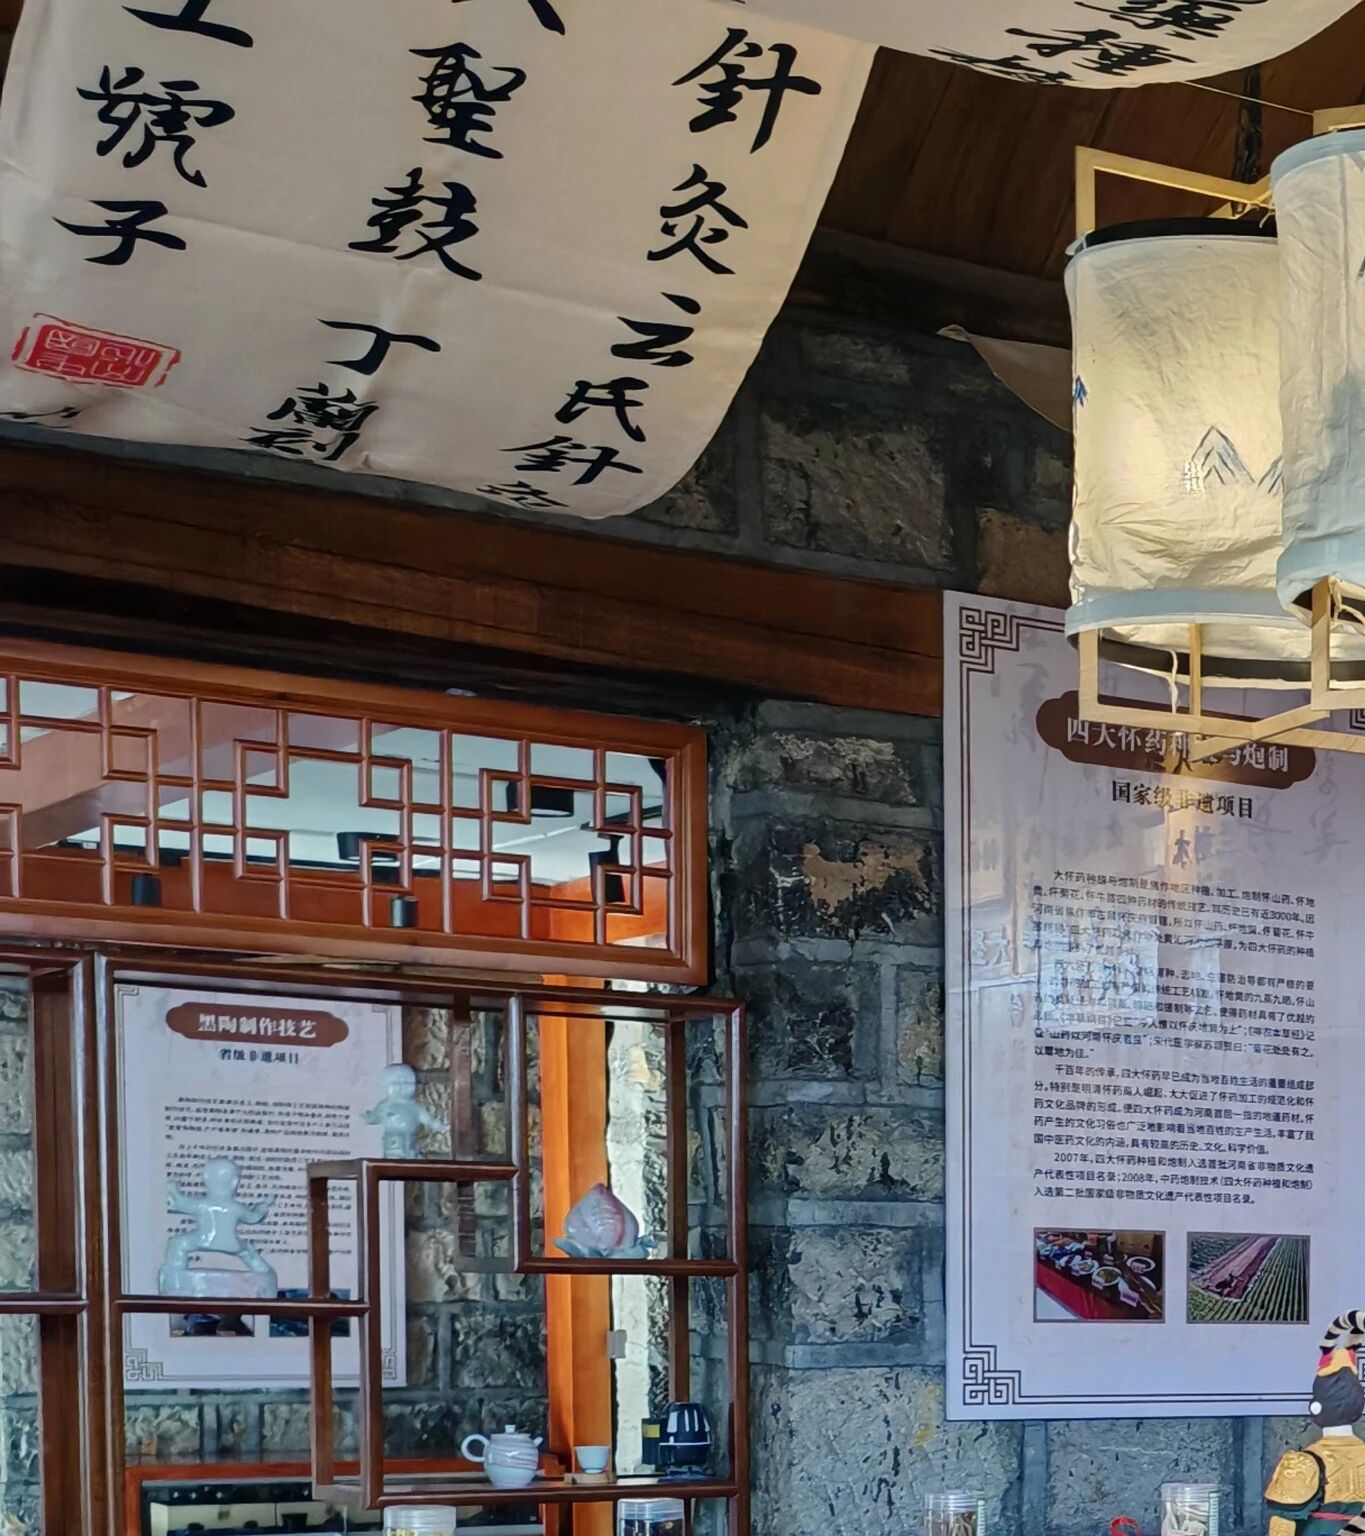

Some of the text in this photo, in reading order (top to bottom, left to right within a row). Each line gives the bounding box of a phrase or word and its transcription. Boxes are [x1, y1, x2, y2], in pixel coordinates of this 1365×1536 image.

[1112, 780, 1253, 819] 国家级非遗项目
[198, 1013, 317, 1040] 黑陶制作技艺
